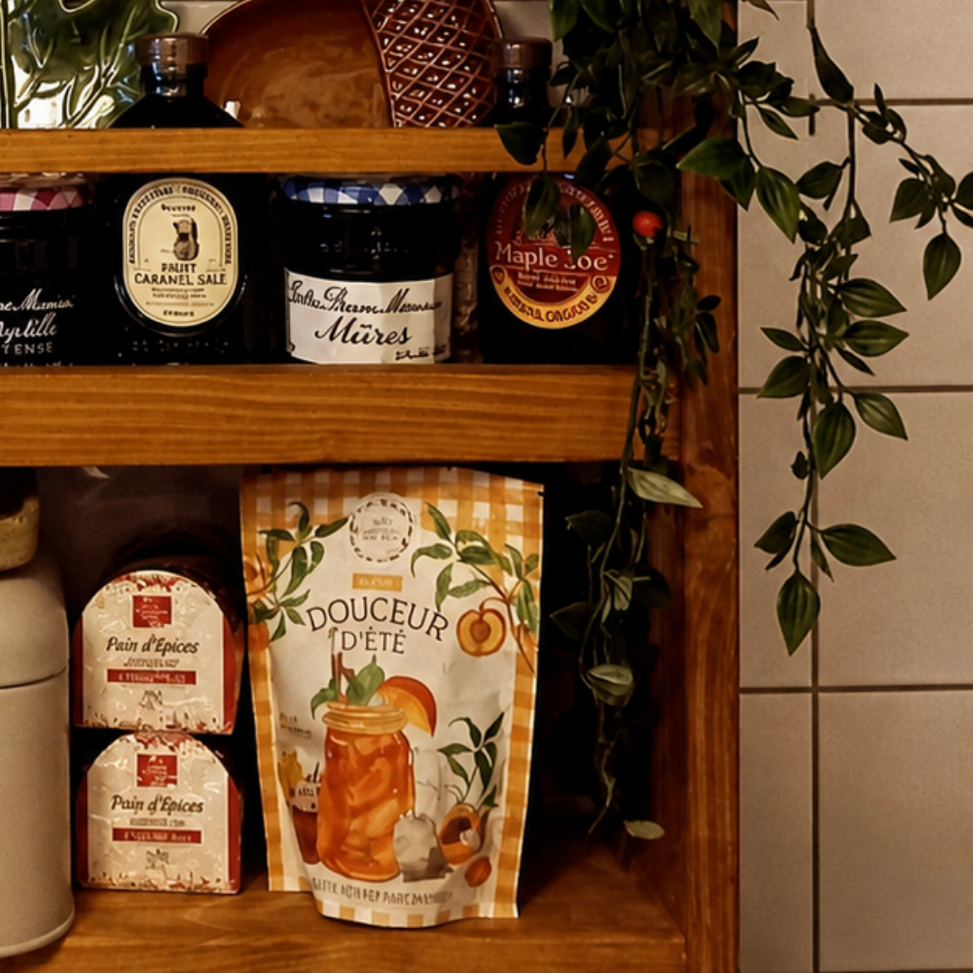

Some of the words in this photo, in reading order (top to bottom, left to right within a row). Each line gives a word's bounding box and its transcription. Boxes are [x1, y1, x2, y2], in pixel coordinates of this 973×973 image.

[494, 241, 559, 271] Maple
[306, 596, 449, 642] DOUCEUR
[106, 636, 138, 653] Pain
[341, 626, 407, 655] D'ÉTÉ
[111, 794, 145, 815] Pain
